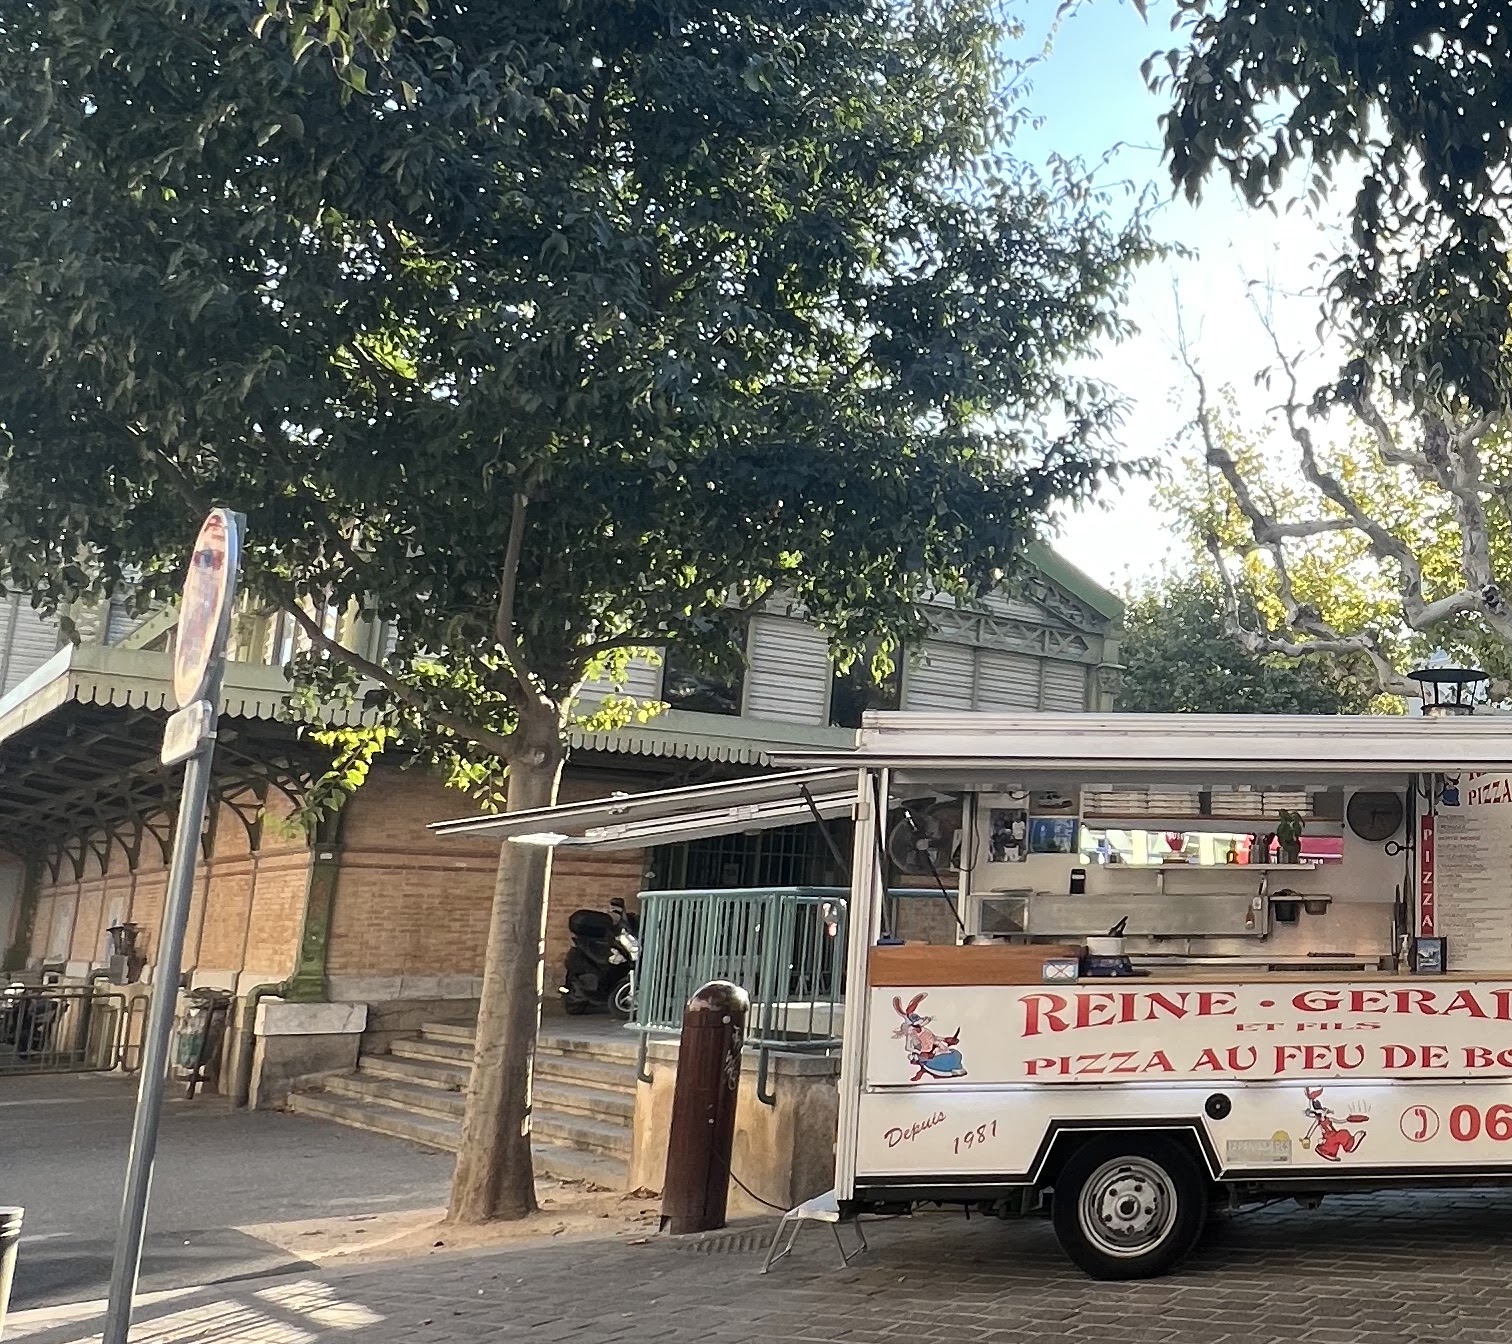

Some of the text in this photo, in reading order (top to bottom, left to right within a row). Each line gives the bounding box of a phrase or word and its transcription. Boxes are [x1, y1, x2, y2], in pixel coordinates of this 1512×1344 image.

[1468, 779, 1512, 806] PIZZA
[1422, 828, 1433, 928] PIZZA
[1018, 991, 1239, 1038] REINE
[1236, 1021, 1381, 1032] ET FILS
[1023, 1049, 1178, 1076] PIZZA
[1190, 1045, 1258, 1072] AU
[1273, 1043, 1365, 1075] FEU
[1380, 1044, 1450, 1070] DE
[883, 1111, 947, 1148] Depuis
[953, 1120, 998, 1155] 1981
